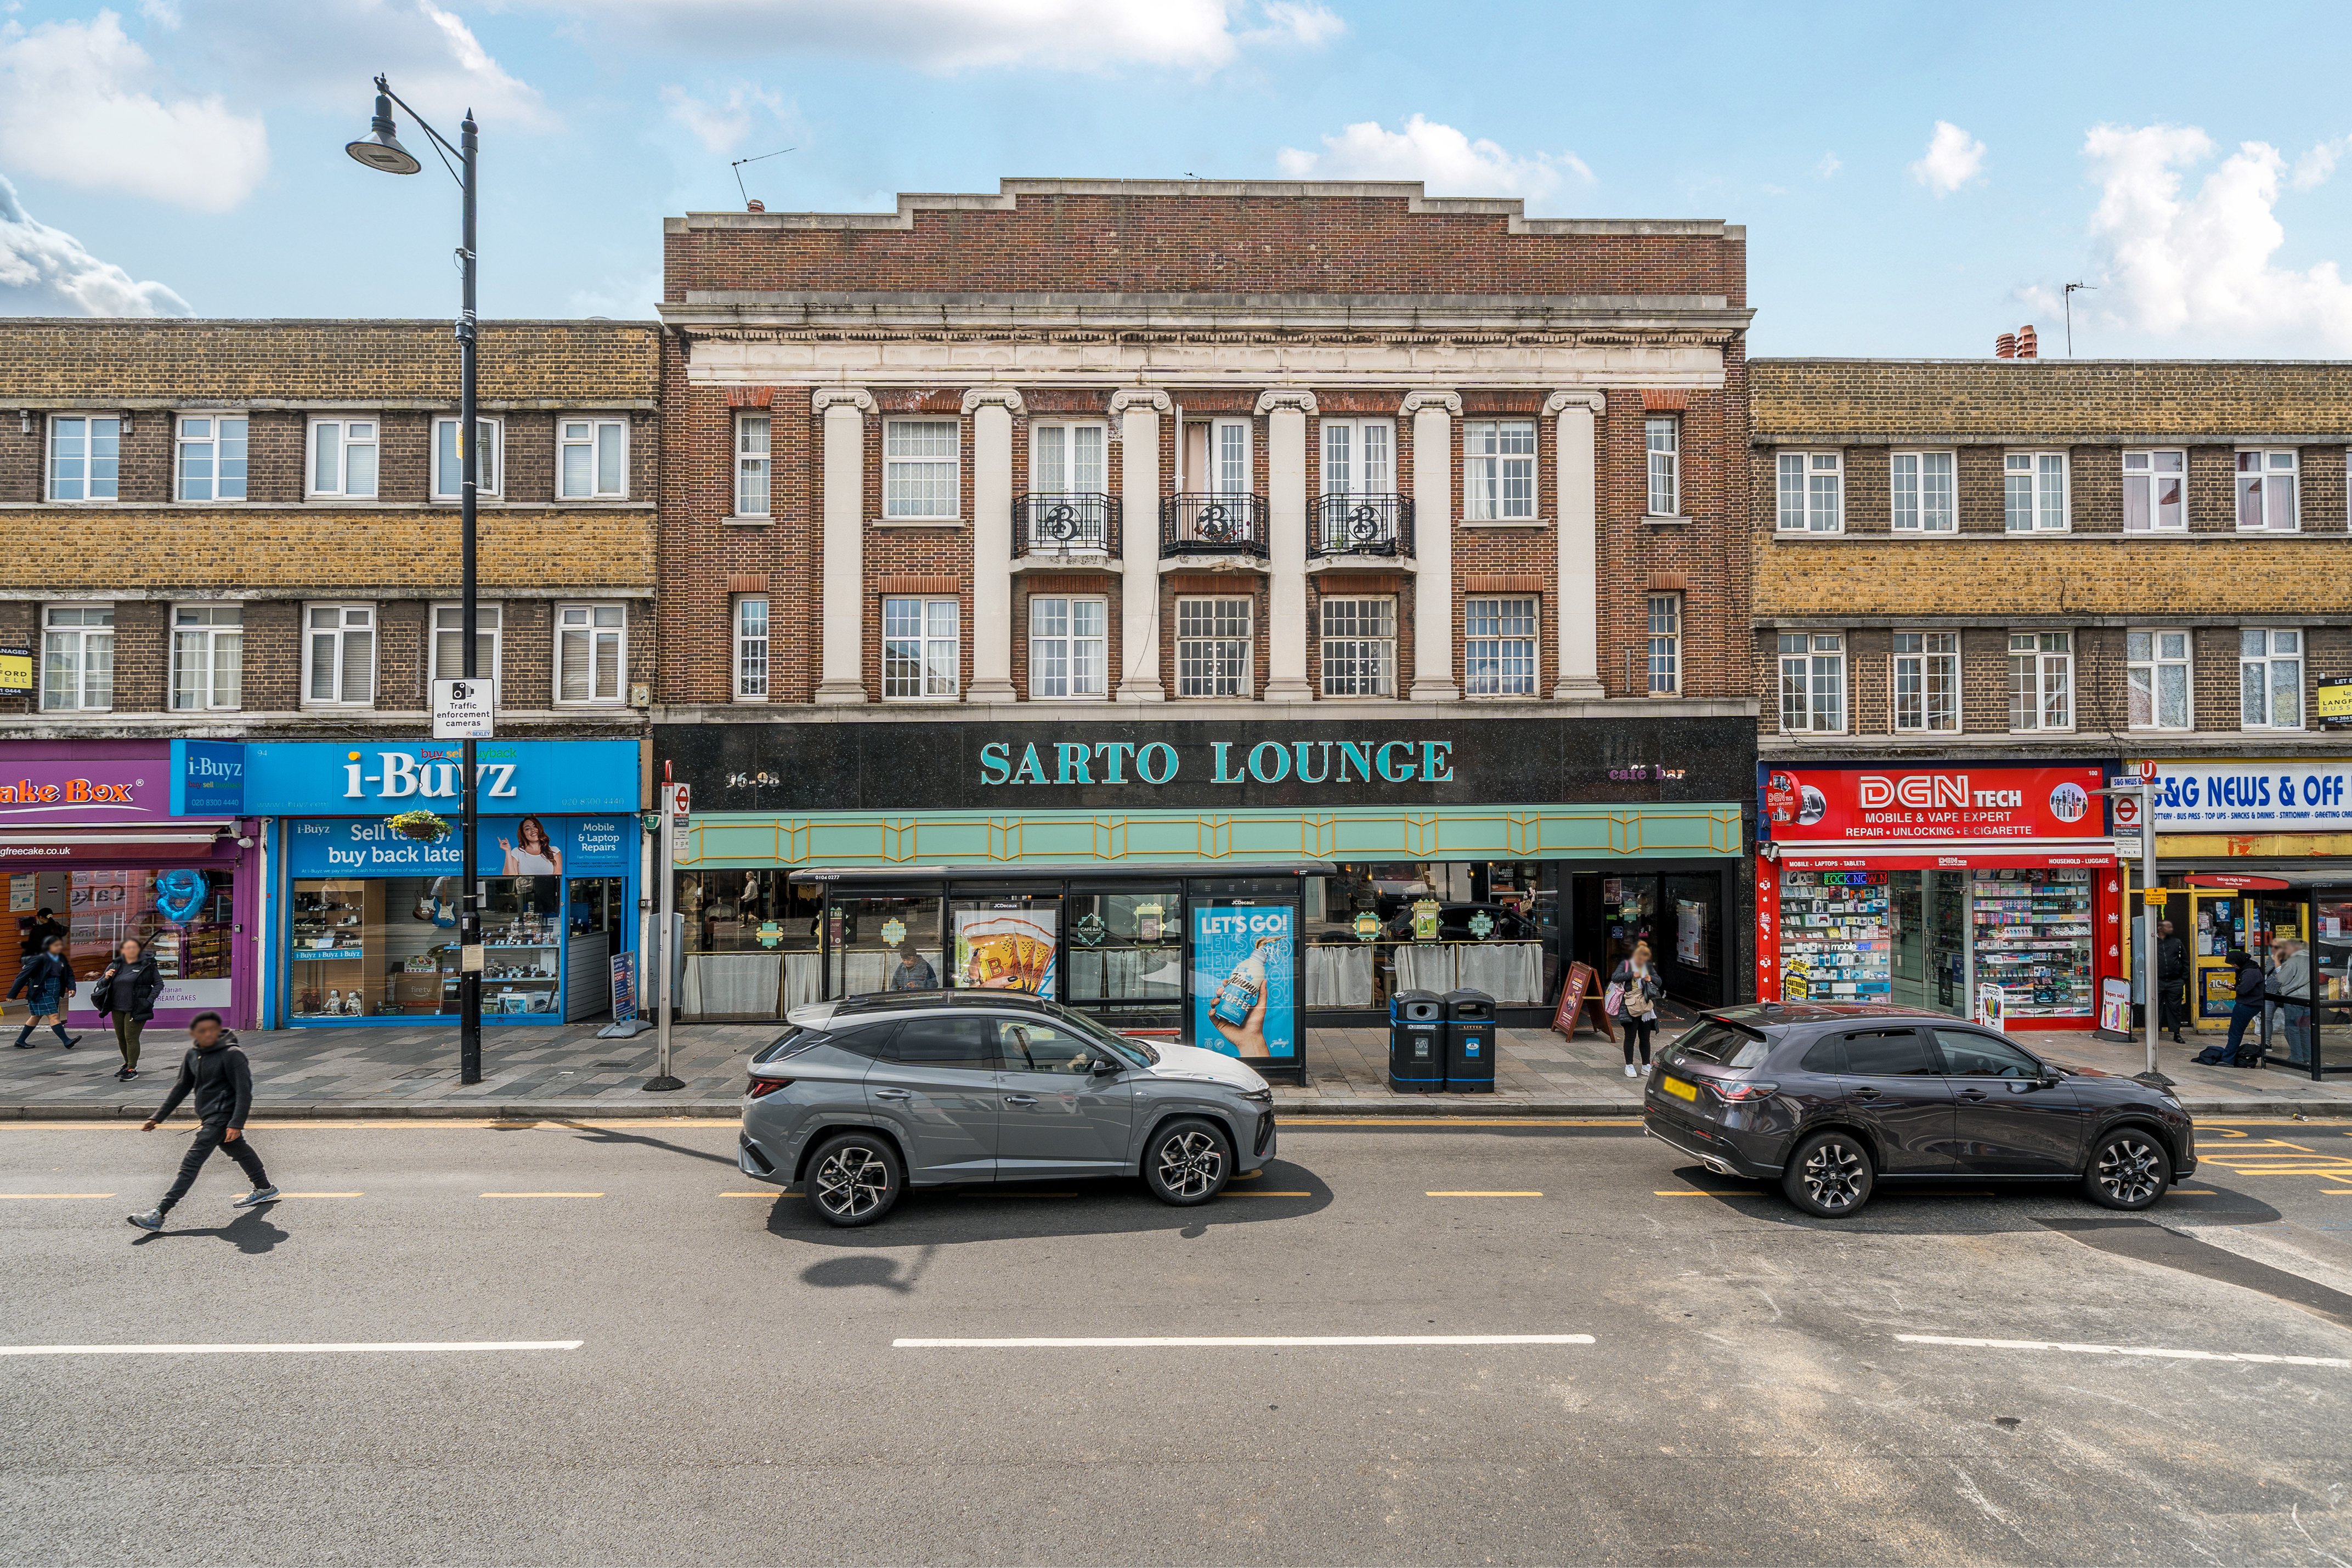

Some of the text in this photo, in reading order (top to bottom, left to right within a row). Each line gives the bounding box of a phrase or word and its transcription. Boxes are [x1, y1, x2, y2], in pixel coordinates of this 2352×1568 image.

[421, 748, 443, 760] buy
[476, 748, 517, 761] uyback
[188, 756, 242, 781] i-Buyz
[981, 741, 1454, 785] SARTO LOUNGE
[1609, 764, 1686, 780] café bar
[188, 781, 201, 789] buy
[725, 772, 779, 788] 96-98
[65, 779, 133, 802] Box
[1859, 775, 2022, 808] DGN TECH
[2208, 776, 2270, 807] NEWS
[2278, 776, 2296, 806] &
[2303, 775, 2343, 806] OFF
[1865, 811, 2011, 823] MOBILE & VAPE EXPERT
[297, 824, 330, 836] i-Buyz
[350, 824, 386, 841] Sell
[583, 823, 615, 831] Mobile
[1846, 825, 2032, 836] REPAIR UNLOCKING E-CIGARETTE
[578, 834, 619, 843] & Laptop
[582, 843, 616, 853] Repairs
[328, 847, 366, 867] buy
[371, 846, 419, 863] back
[1853, 874, 1876, 884] NOW
[1202, 914, 1287, 934] LET'S GO!
[1202, 933, 1248, 952] LET'S
[1831, 942, 1856, 950] mobile
[1856, 941, 1872, 950] and
[986, 957, 1004, 978] B
[1793, 960, 1806, 969] CARTRIDGE
[1787, 978, 1806, 989] CARTRIDGE
[1791, 987, 1802, 995] REFILL
[1221, 992, 1252, 1012] COFFEE
[1222, 1005, 1242, 1018] ORIGINAL
[1270, 1039, 1289, 1048] Jimmy's
